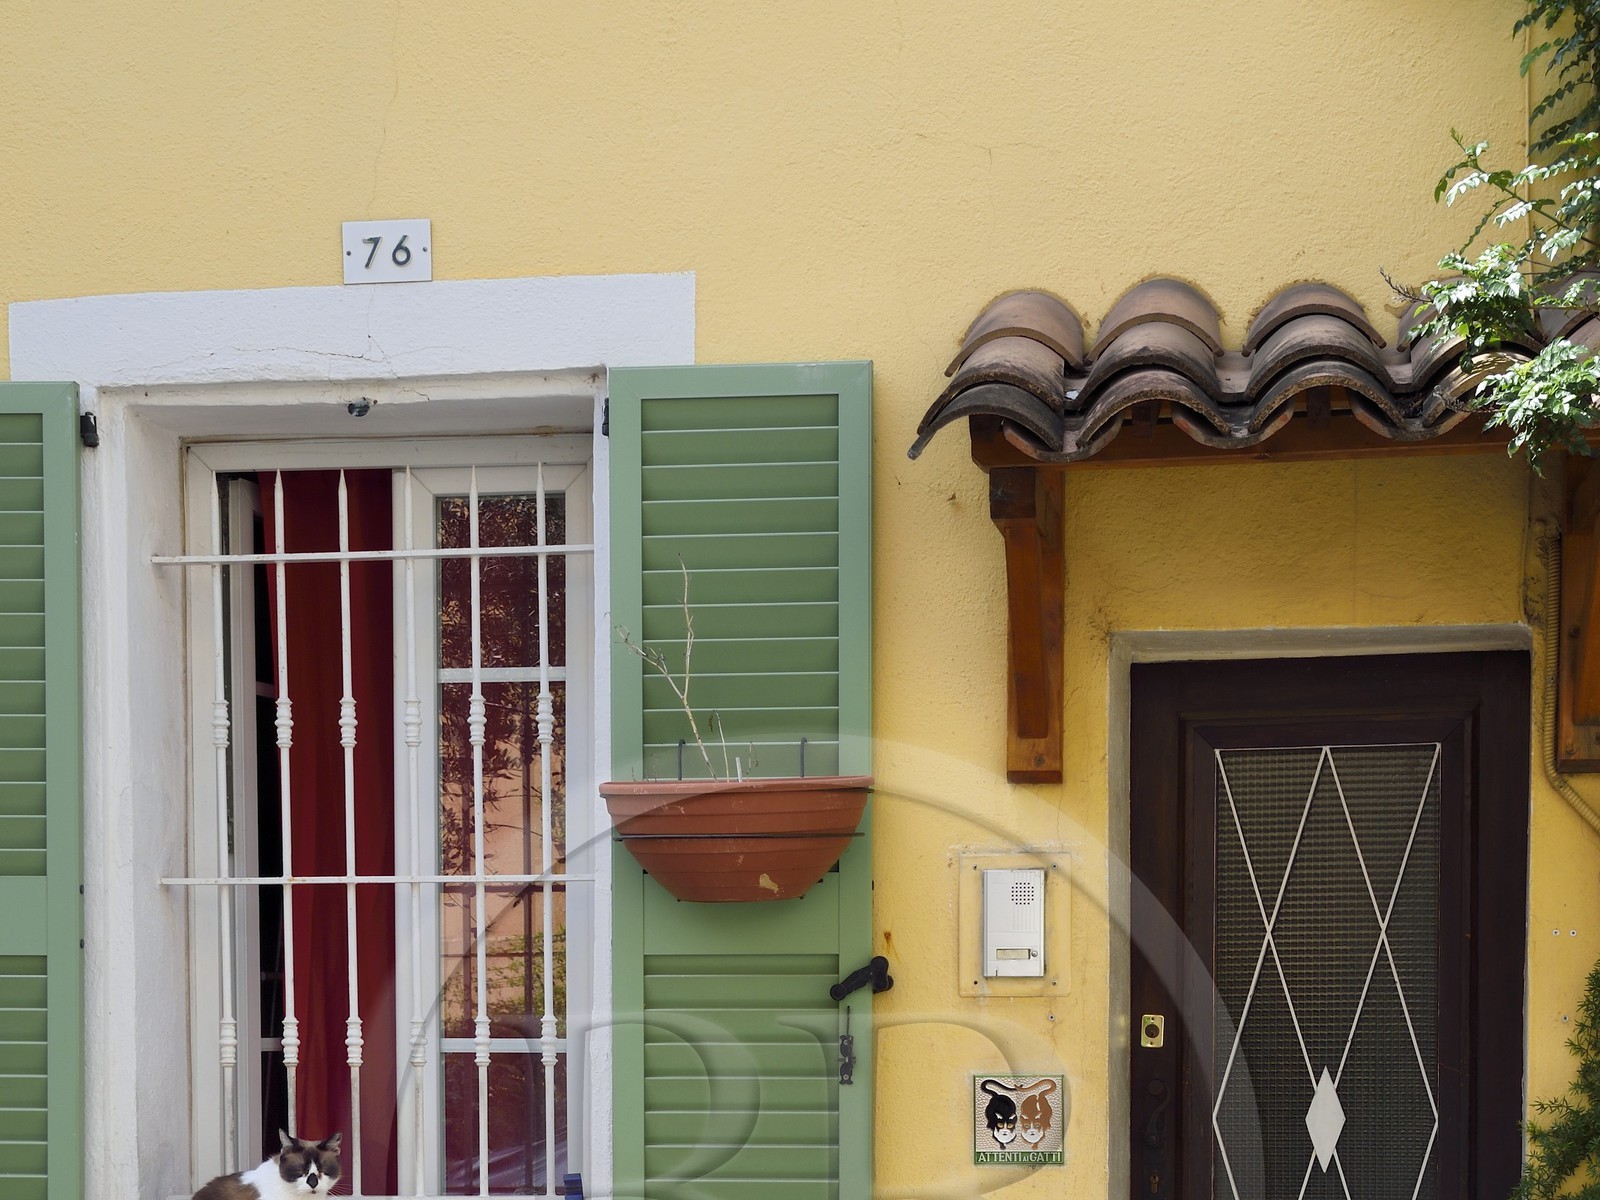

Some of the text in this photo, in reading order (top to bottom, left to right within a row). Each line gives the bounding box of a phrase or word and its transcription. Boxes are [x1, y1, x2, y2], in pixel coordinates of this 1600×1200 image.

[362, 234, 411, 269] 76
[978, 1152, 1022, 1162] ATTENTI
[1029, 1152, 1061, 1162] GATTI
